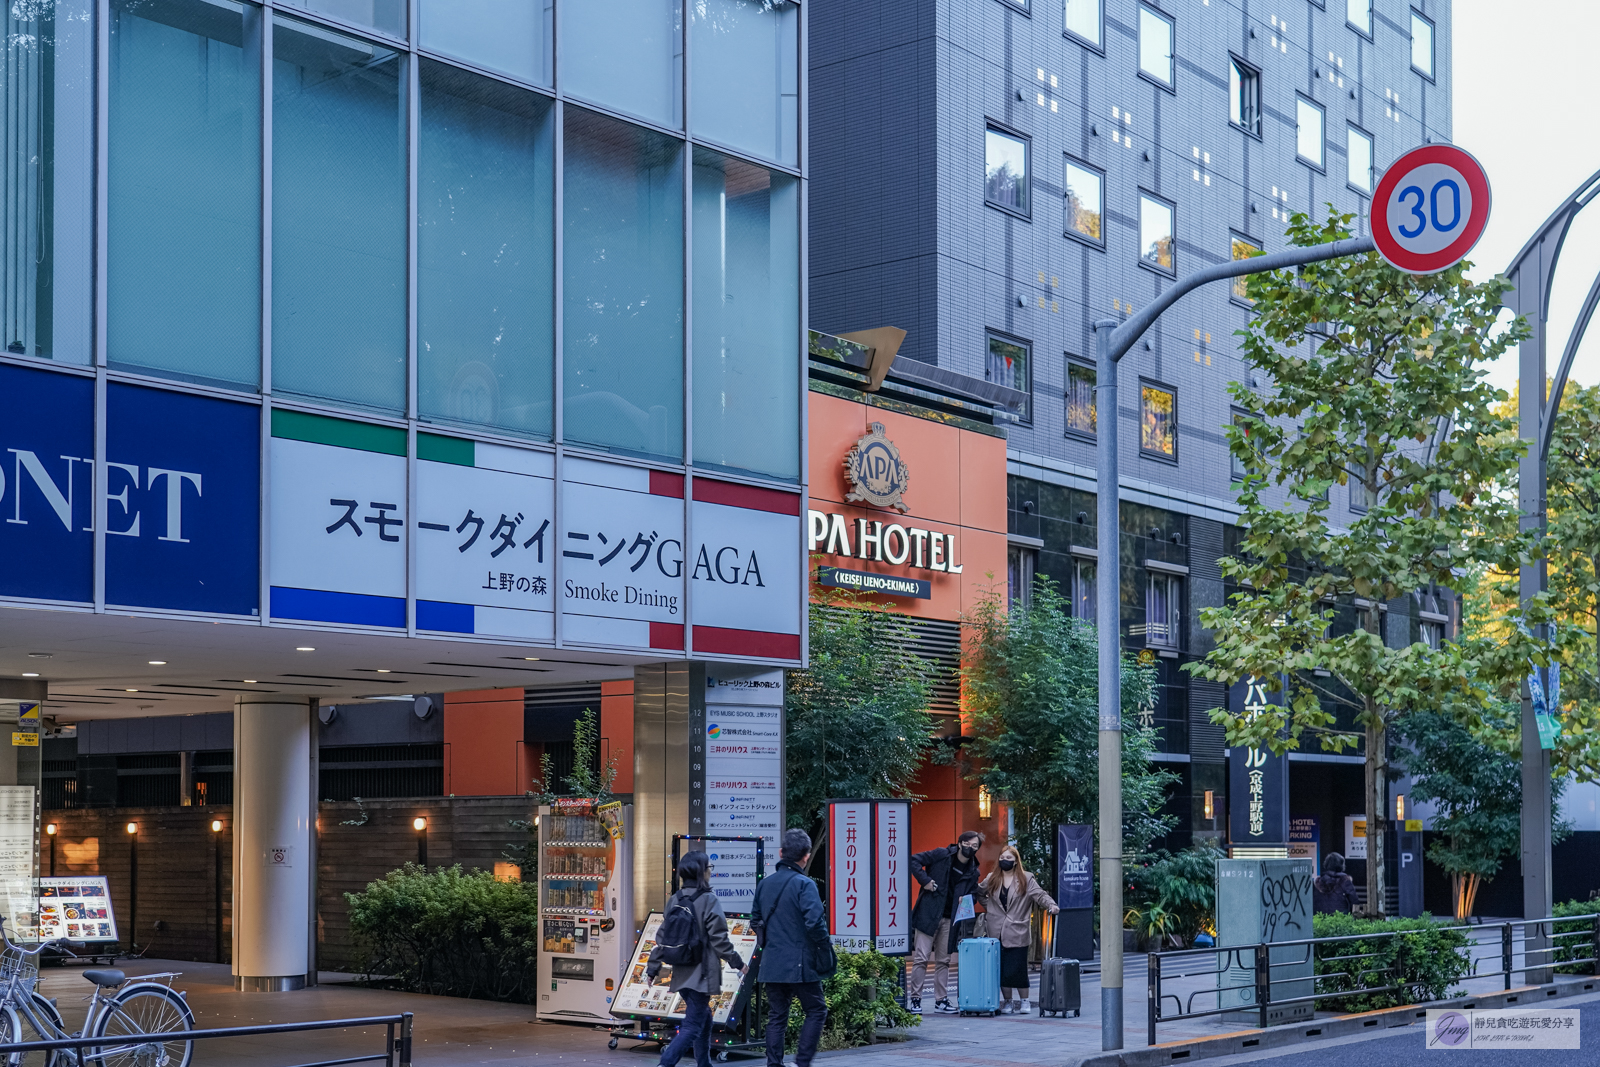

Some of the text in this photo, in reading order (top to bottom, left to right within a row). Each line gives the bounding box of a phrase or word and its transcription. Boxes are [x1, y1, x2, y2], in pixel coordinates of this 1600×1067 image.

[1398, 179, 1461, 238] 30
[860, 453, 899, 485] APA
[0, 447, 202, 543] NET
[808, 509, 964, 575] PA HOTEL
[482, 571, 678, 615] 上野の森 Smoke Dining
[1243, 674, 1268, 768] パホル
[710, 746, 748, 754] 三井のリハウス
[710, 781, 748, 789] 三井のリハウス
[846, 810, 858, 928] 三井のリハウス
[887, 810, 898, 928] 三井のリハウス
[1401, 852, 1413, 868] P
[734, 888, 755, 897] MON
[834, 938, 868, 949] 当ビル 8F
[877, 938, 905, 949] 当ビル 8F
